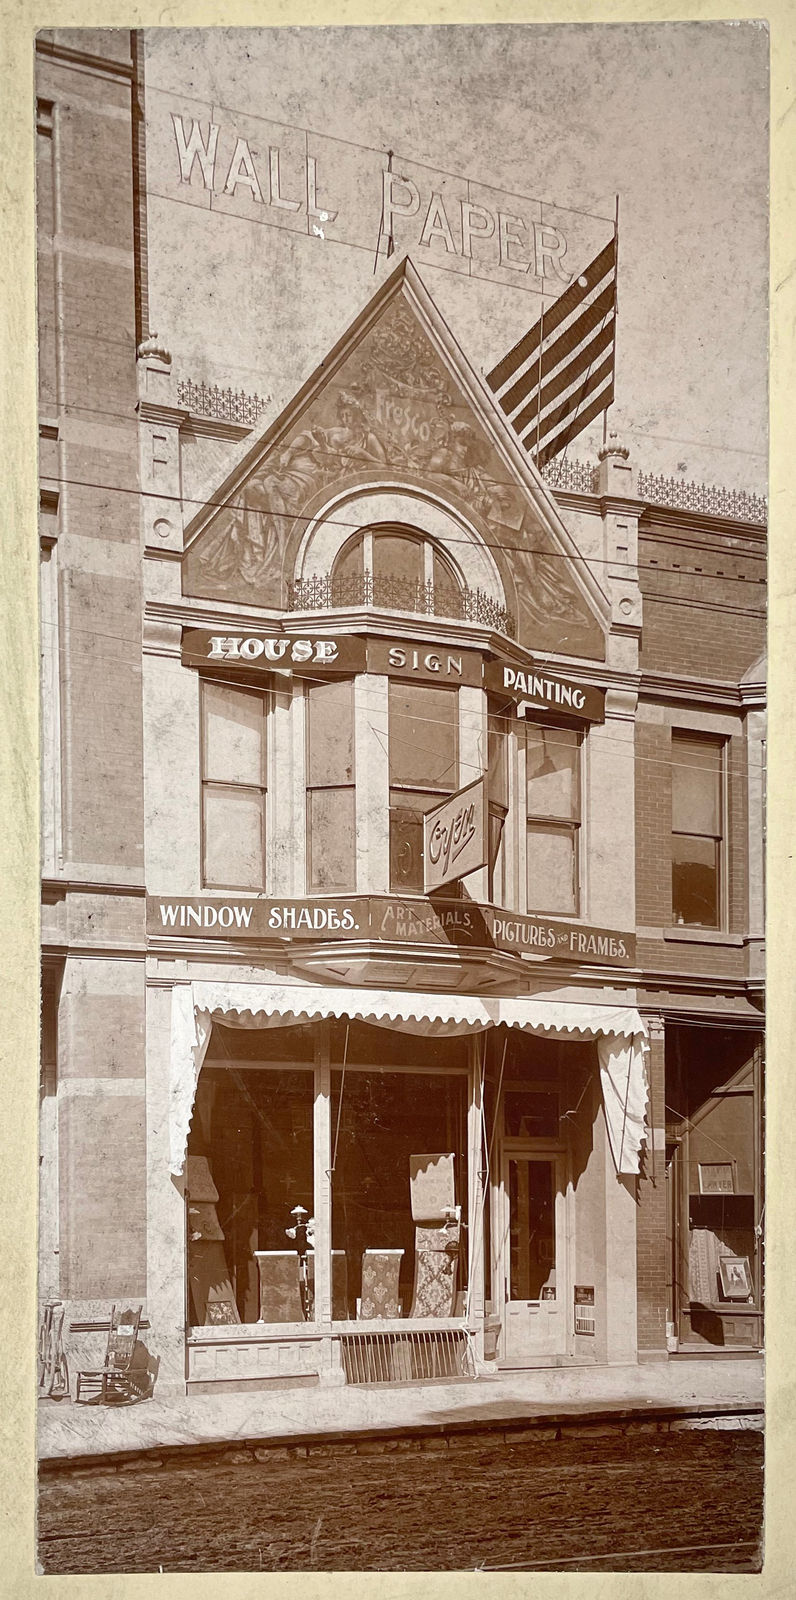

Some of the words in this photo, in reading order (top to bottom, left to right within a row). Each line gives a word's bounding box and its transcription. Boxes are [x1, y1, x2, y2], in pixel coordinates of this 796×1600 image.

[169, 112, 338, 222] WALL
[381, 168, 576, 283] PAPER
[207, 636, 339, 664] HOUSE
[388, 647, 462, 676] SIGN
[503, 666, 586, 709] PAINTING
[160, 904, 253, 927] WINDOW
[268, 907, 360, 930] SHADES.
[396, 911, 474, 937] MATERIALS.
[493, 919, 556, 948] PICTURES
[570, 932, 630, 960] FRAMES.
